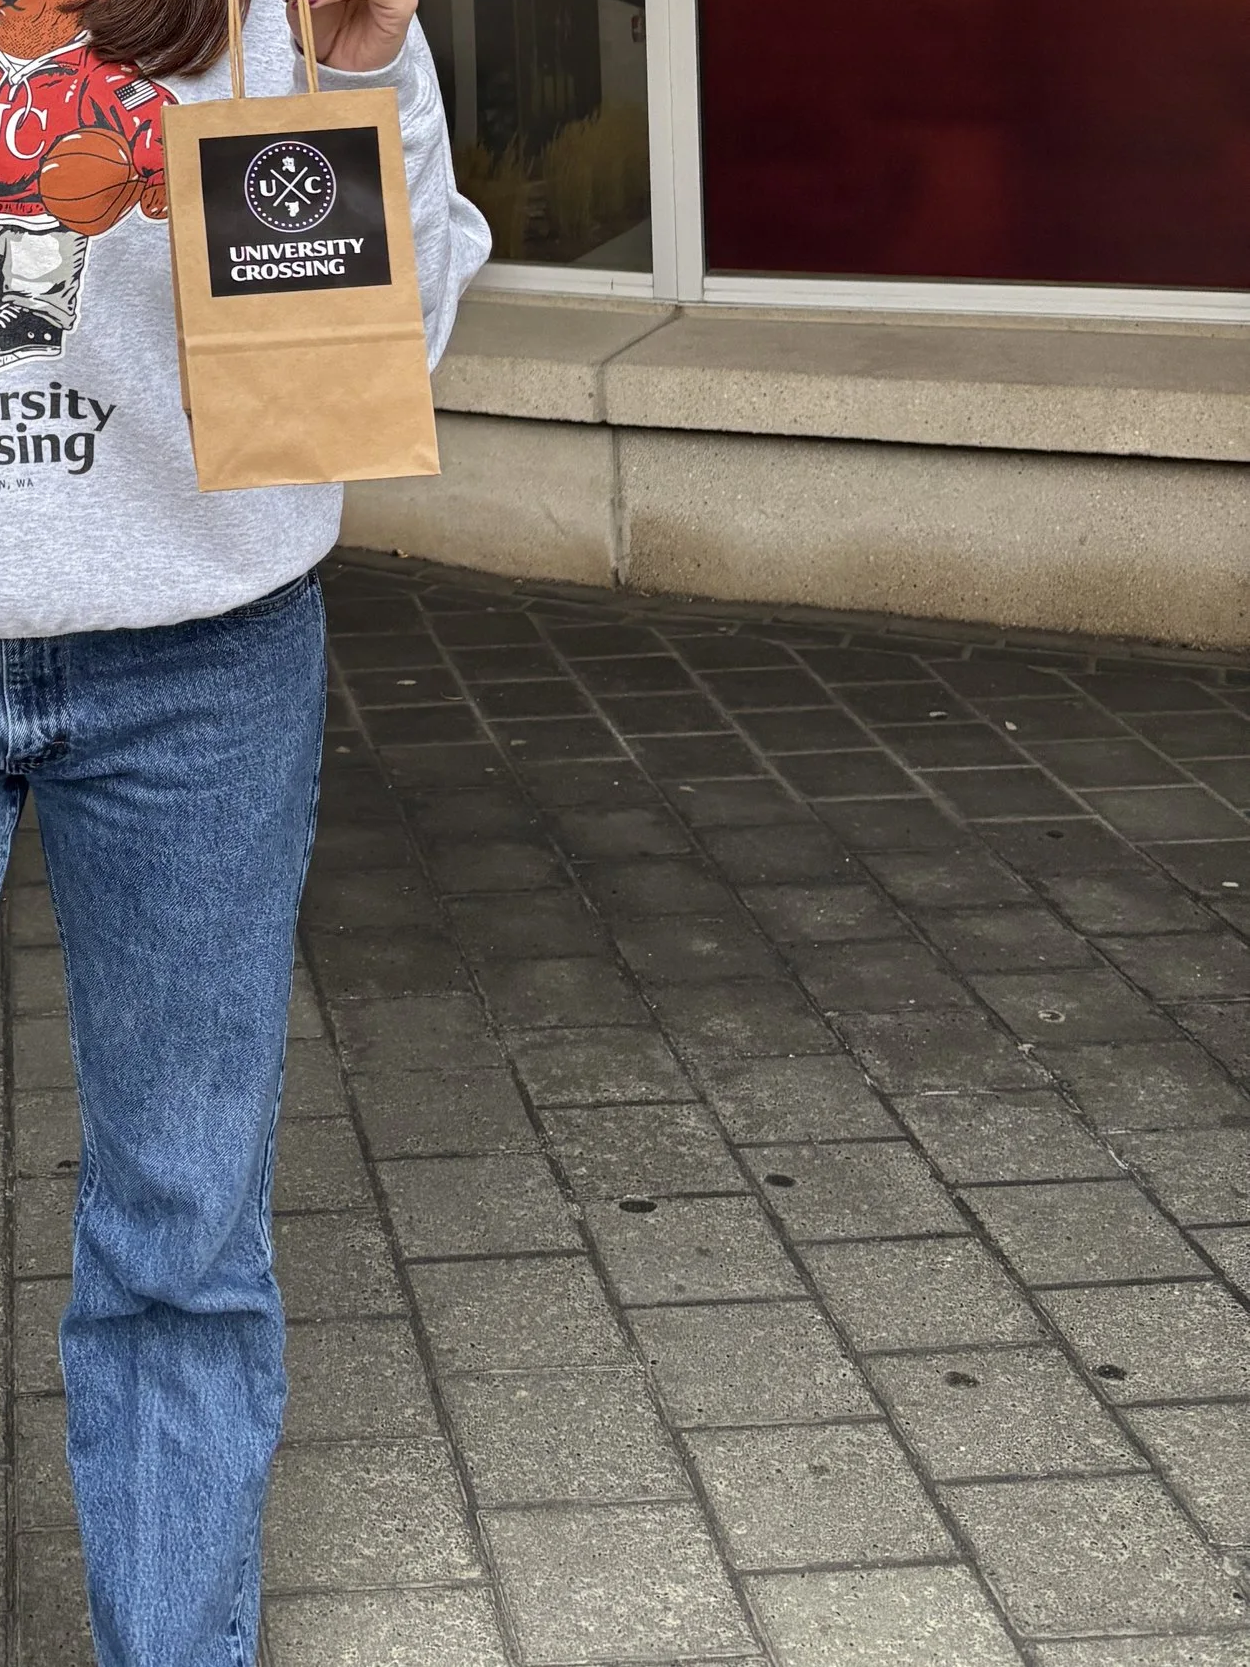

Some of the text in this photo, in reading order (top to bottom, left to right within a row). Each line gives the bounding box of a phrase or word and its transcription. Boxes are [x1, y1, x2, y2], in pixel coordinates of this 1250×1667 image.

[259, 176, 322, 197] U C
[229, 237, 365, 262] UNIVERSITY
[230, 258, 346, 282] CROSSING
[16, 477, 35, 488] WA
